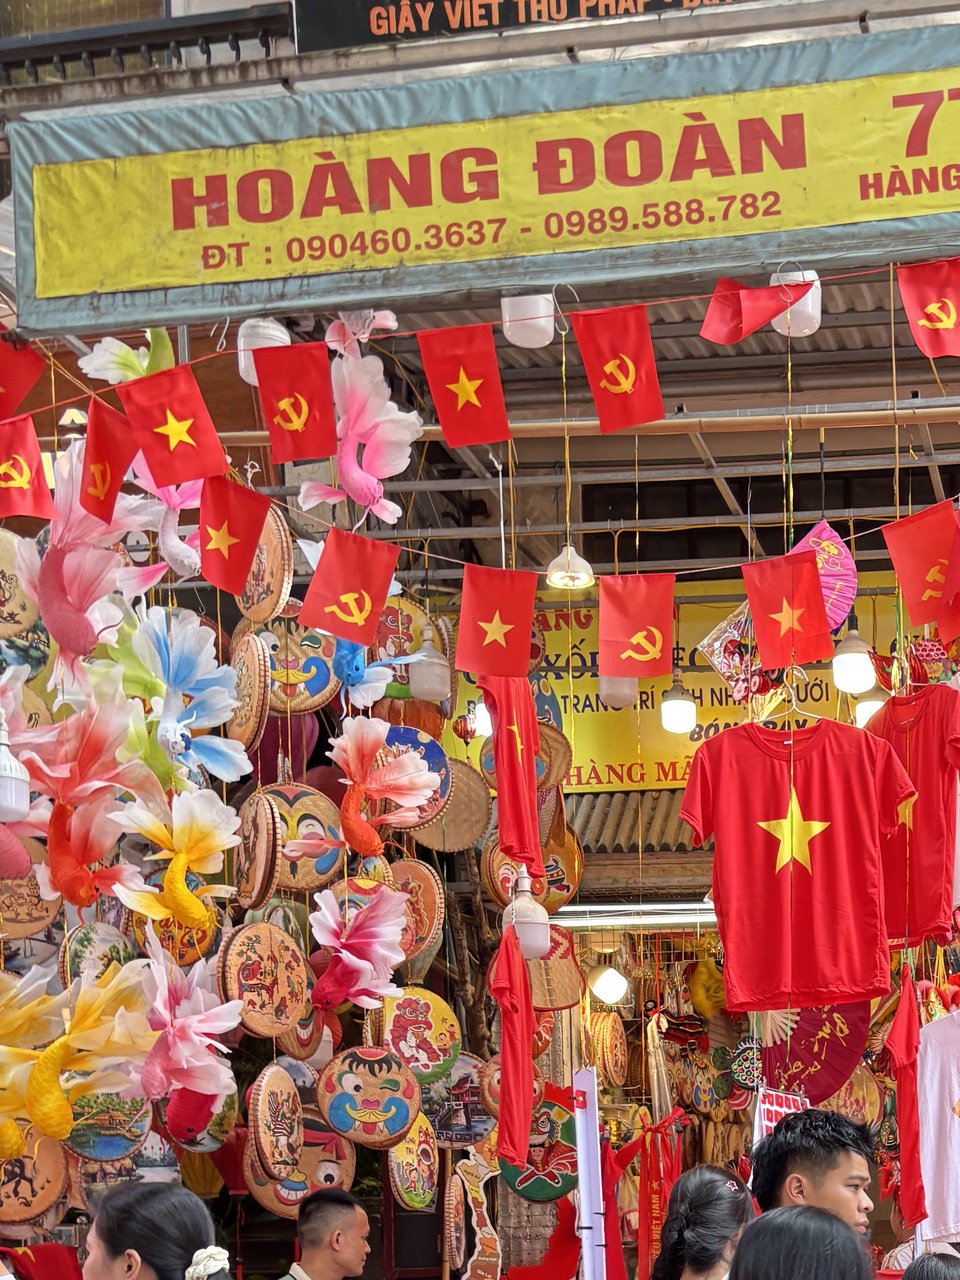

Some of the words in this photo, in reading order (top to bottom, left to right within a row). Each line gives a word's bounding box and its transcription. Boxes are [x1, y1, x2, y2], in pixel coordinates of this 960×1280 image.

[171, 147, 499, 231] HOÀNG
[533, 112, 807, 195] ĐOÀN
[201, 242, 250, 270] ĐT
[286, 217, 507, 263] 090460.3637
[544, 190, 782, 239] 0989.588.782
[561, 692, 623, 714] TRAN
[565, 759, 647, 786] HÀNG
[652, 1194, 660, 1217] NAM
